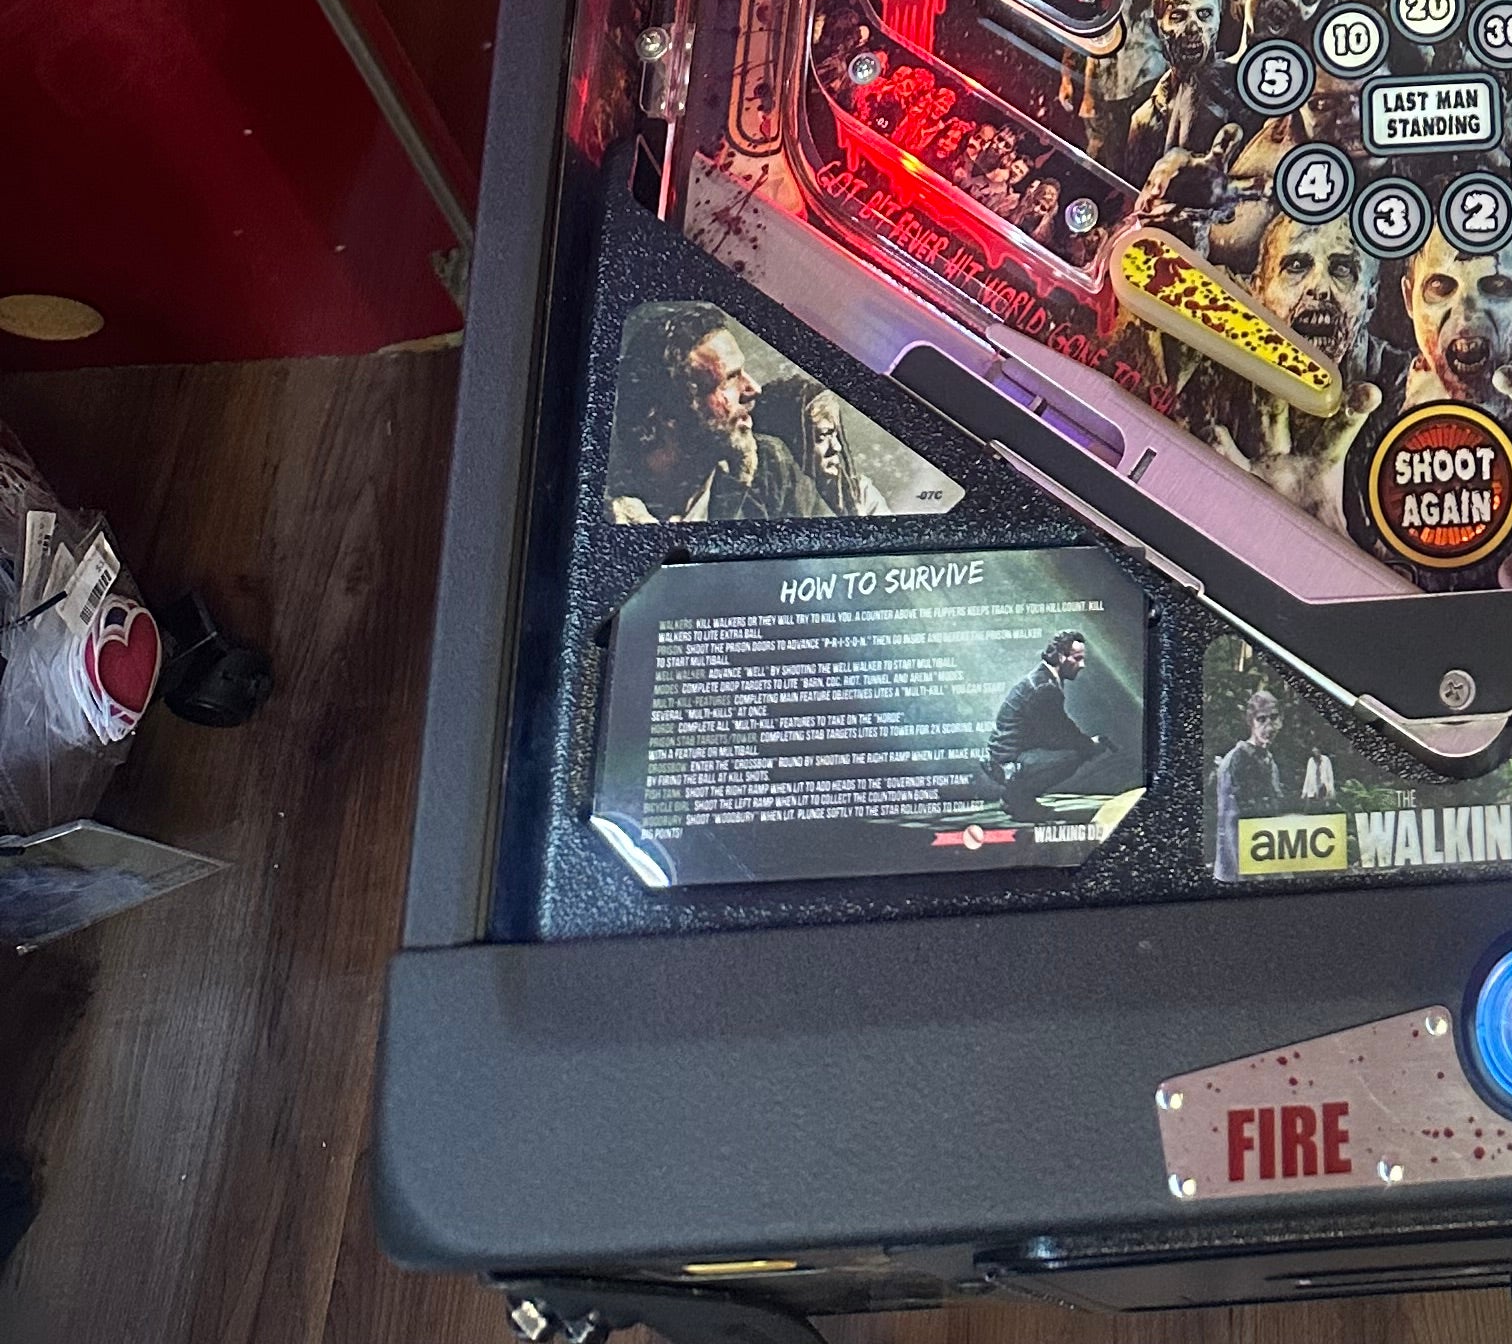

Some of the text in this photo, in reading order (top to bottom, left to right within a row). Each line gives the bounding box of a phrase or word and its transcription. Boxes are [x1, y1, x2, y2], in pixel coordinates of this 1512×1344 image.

[1333, 22, 1371, 57] 10
[1258, 56, 1291, 97] 5
[1384, 88, 1479, 113] LAST MAN
[1387, 113, 1481, 139] STANDING
[1296, 160, 1334, 202] 4
[1375, 197, 1408, 238] 3
[1462, 191, 1499, 233] 2
[888, 212, 950, 264] FEVER
[944, 247, 984, 288] HIT
[981, 274, 1046, 334] WORLD
[1395, 447, 1495, 485] SHOOT
[1402, 488, 1492, 527] AGAIN
[780, 560, 984, 604] HOW TO SURVIVE
[1395, 789, 1417, 808] THE
[1034, 824, 1085, 843] WALKING
[1226, 1100, 1352, 1182] FIRE
